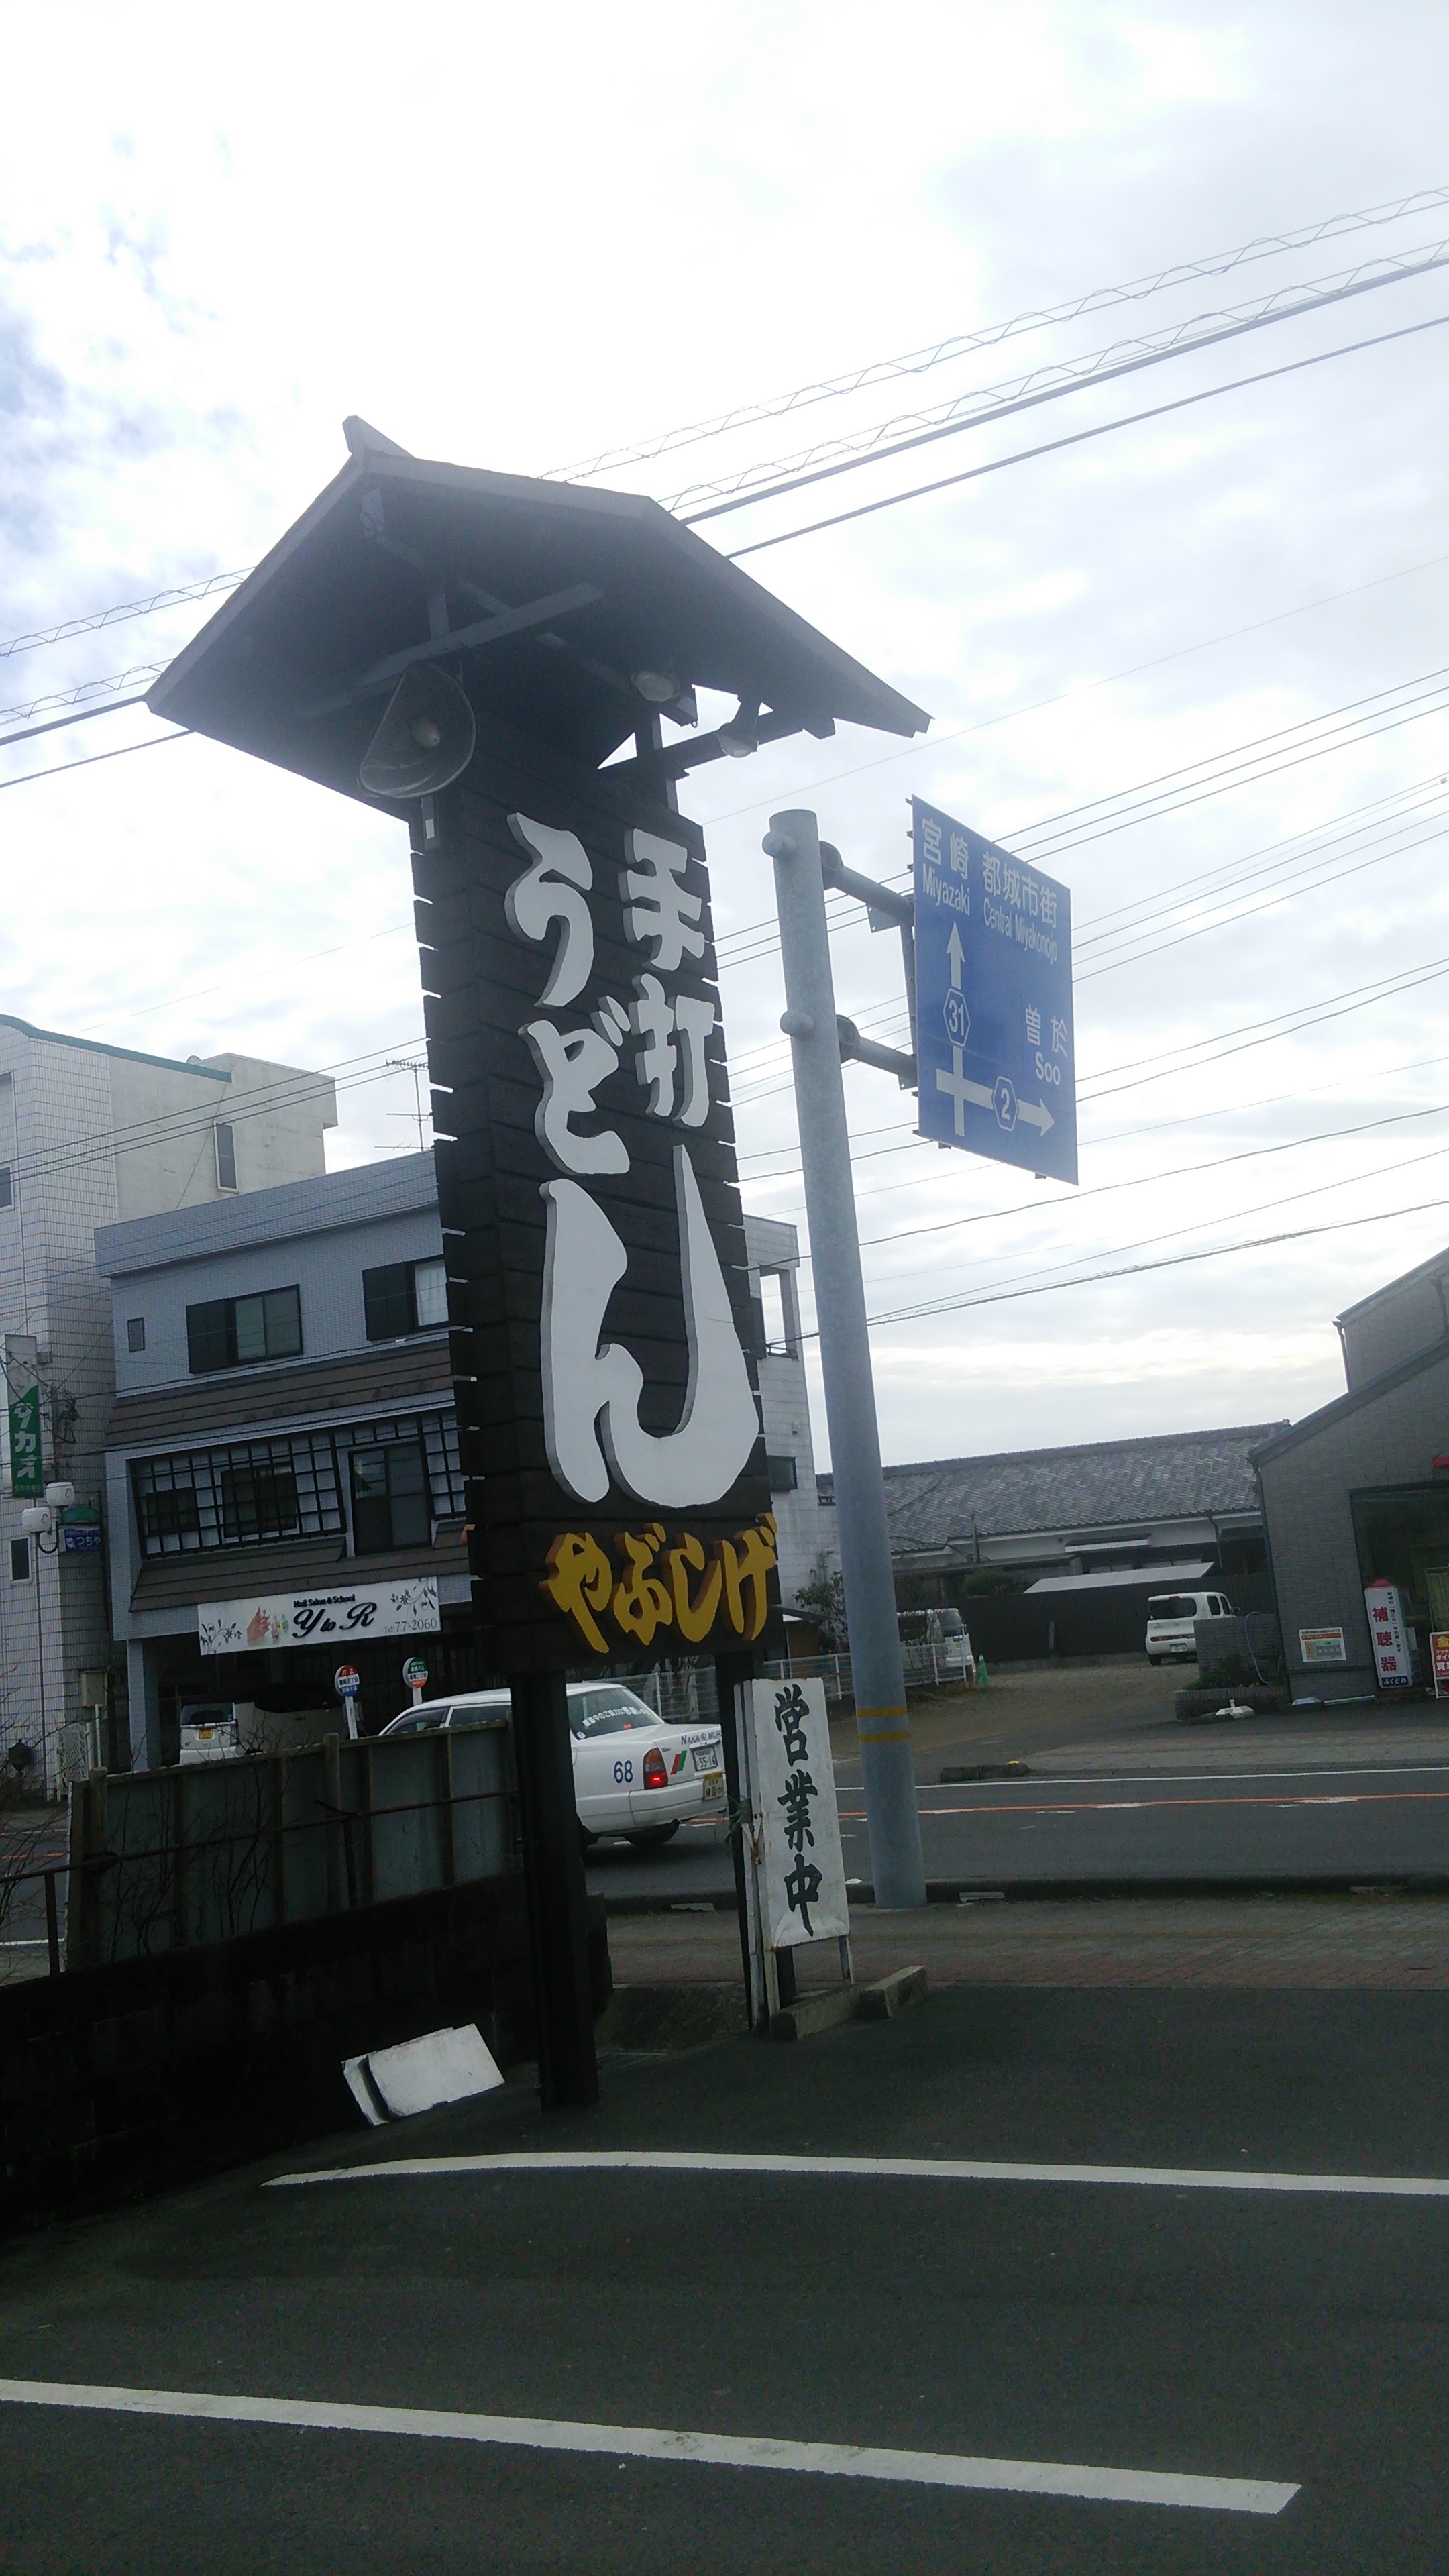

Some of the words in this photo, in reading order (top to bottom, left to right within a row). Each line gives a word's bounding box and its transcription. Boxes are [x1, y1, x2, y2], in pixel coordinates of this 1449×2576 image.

[922, 818, 969, 880] 宮崎
[922, 863, 970, 916] Miyazaki
[982, 851, 1057, 929] 都城市街
[983, 897, 1012, 938] Central
[1015, 913, 1058, 965] Miyakonojo
[623, 828, 714, 1129] 手打
[949, 999, 965, 1036] 31
[1035, 1051, 1061, 1085] Soo
[1000, 1087, 1011, 1120] 2
[506, 810, 759, 1508] うどん
[293, 1599, 307, 1608] Nail
[308, 1598, 327, 1607] Salon
[333, 1594, 356, 1604] School
[681, 1734, 700, 1745] NAKA
[708, 1730, 722, 1739] MUR
[613, 1760, 634, 1784] 68
[773, 1683, 823, 1937] 営業中
